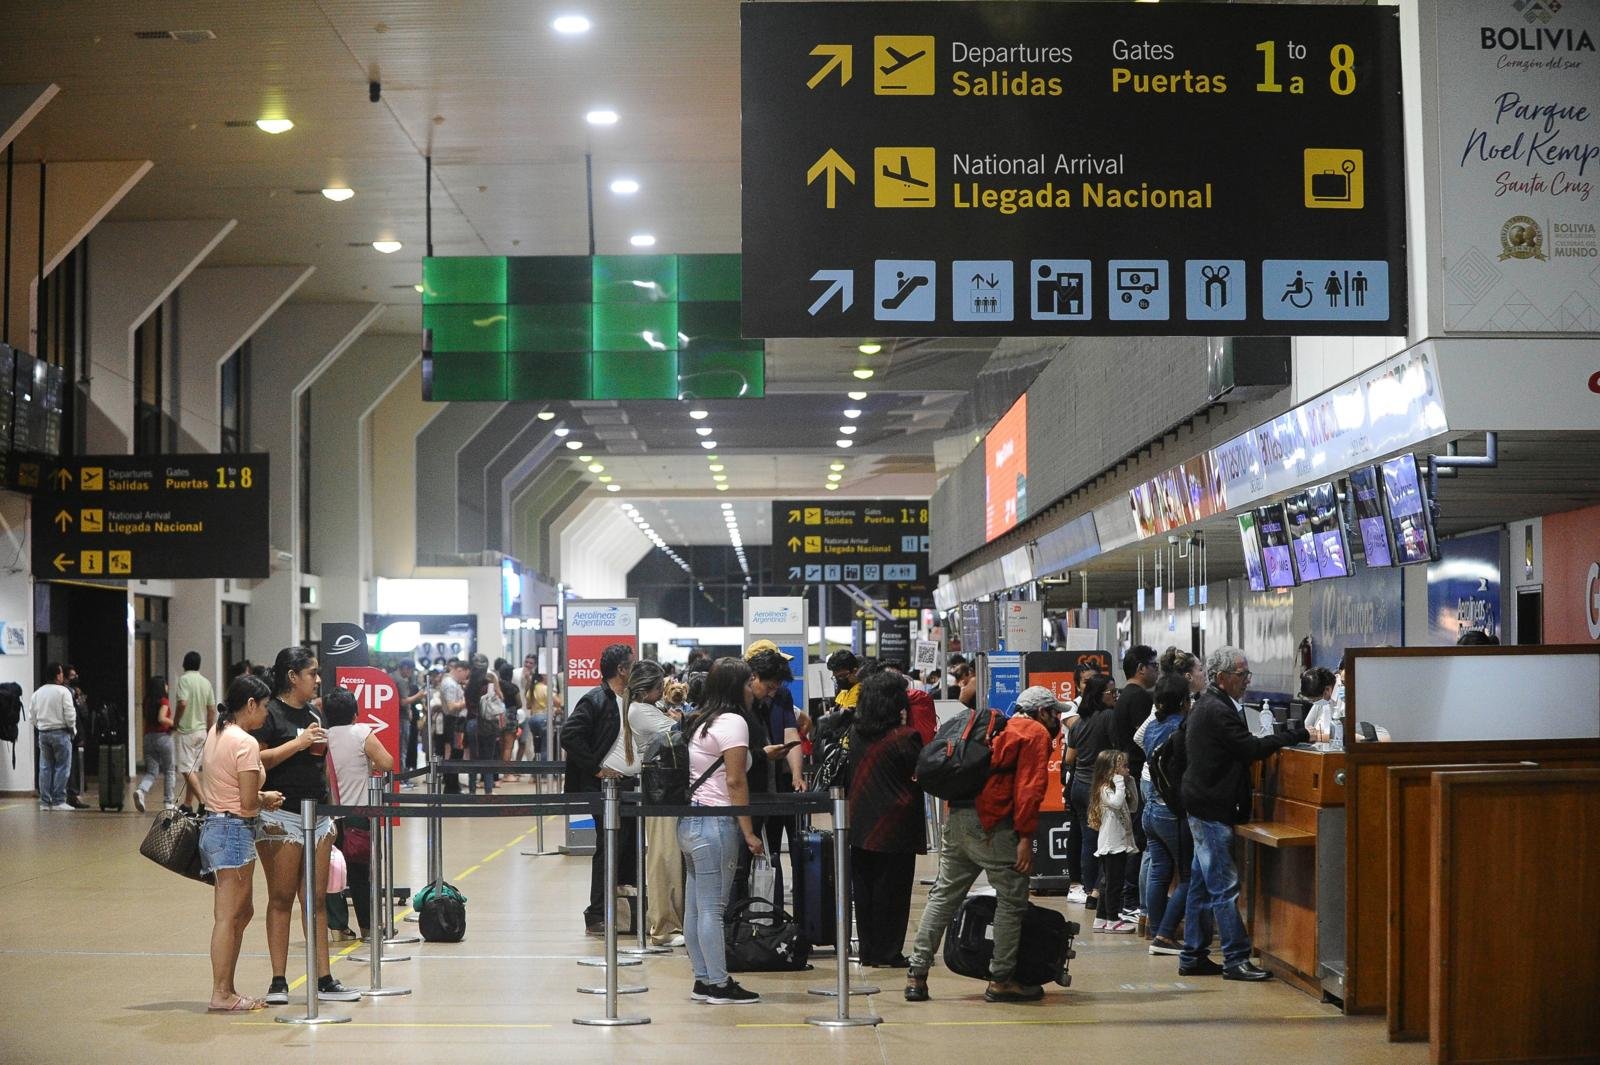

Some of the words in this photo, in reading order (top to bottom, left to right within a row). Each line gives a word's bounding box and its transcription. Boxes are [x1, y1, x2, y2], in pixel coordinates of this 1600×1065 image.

[1481, 27, 1596, 52] BOLIVIA
[952, 41, 1073, 67] Departures
[1112, 40, 1175, 61] Gates
[1255, 40, 1283, 93] 1
[1287, 40, 1307, 60] to
[1329, 43, 1357, 96] 8
[952, 70, 1063, 97] Salidas
[1112, 67, 1227, 93] Puertas
[1289, 76, 1304, 94] a
[1494, 91, 1591, 133] Parque
[1460, 127, 1526, 167] Noel
[1527, 129, 1600, 177] Kemp
[953, 153, 1045, 175] National
[1054, 153, 1124, 175] Arrival
[1494, 170, 1548, 198] Santa
[1550, 170, 1594, 202] Cruz
[954, 182, 1071, 215] Llegada
[1082, 182, 1212, 209] Nacional
[1553, 223, 1596, 233] BOLIVIA
[1554, 247, 1598, 257] MUNDO
[108, 468, 153, 480] Departures
[165, 467, 190, 477] Gates
[216, 467, 227, 489] 1
[228, 467, 237, 476] to
[241, 467, 252, 489] 8
[109, 480, 149, 491] Salidas
[166, 479, 209, 489] Puertas
[228, 480, 236, 489] a
[108, 511, 142, 520] National
[144, 511, 171, 520] Arrival
[824, 516, 853, 525] Salidas
[864, 516, 895, 524] Puertas
[901, 508, 909, 523] 1
[920, 508, 928, 524] 8
[108, 522, 151, 534] Llegada
[154, 522, 203, 532] Nacional
[824, 545, 855, 554] Llegada
[857, 545, 891, 553] Nacional
[572, 619, 616, 628] Argentinas
[568, 658, 596, 669] SKY
[340, 676, 366, 684] Acceso
[568, 669, 603, 680] PRIO
